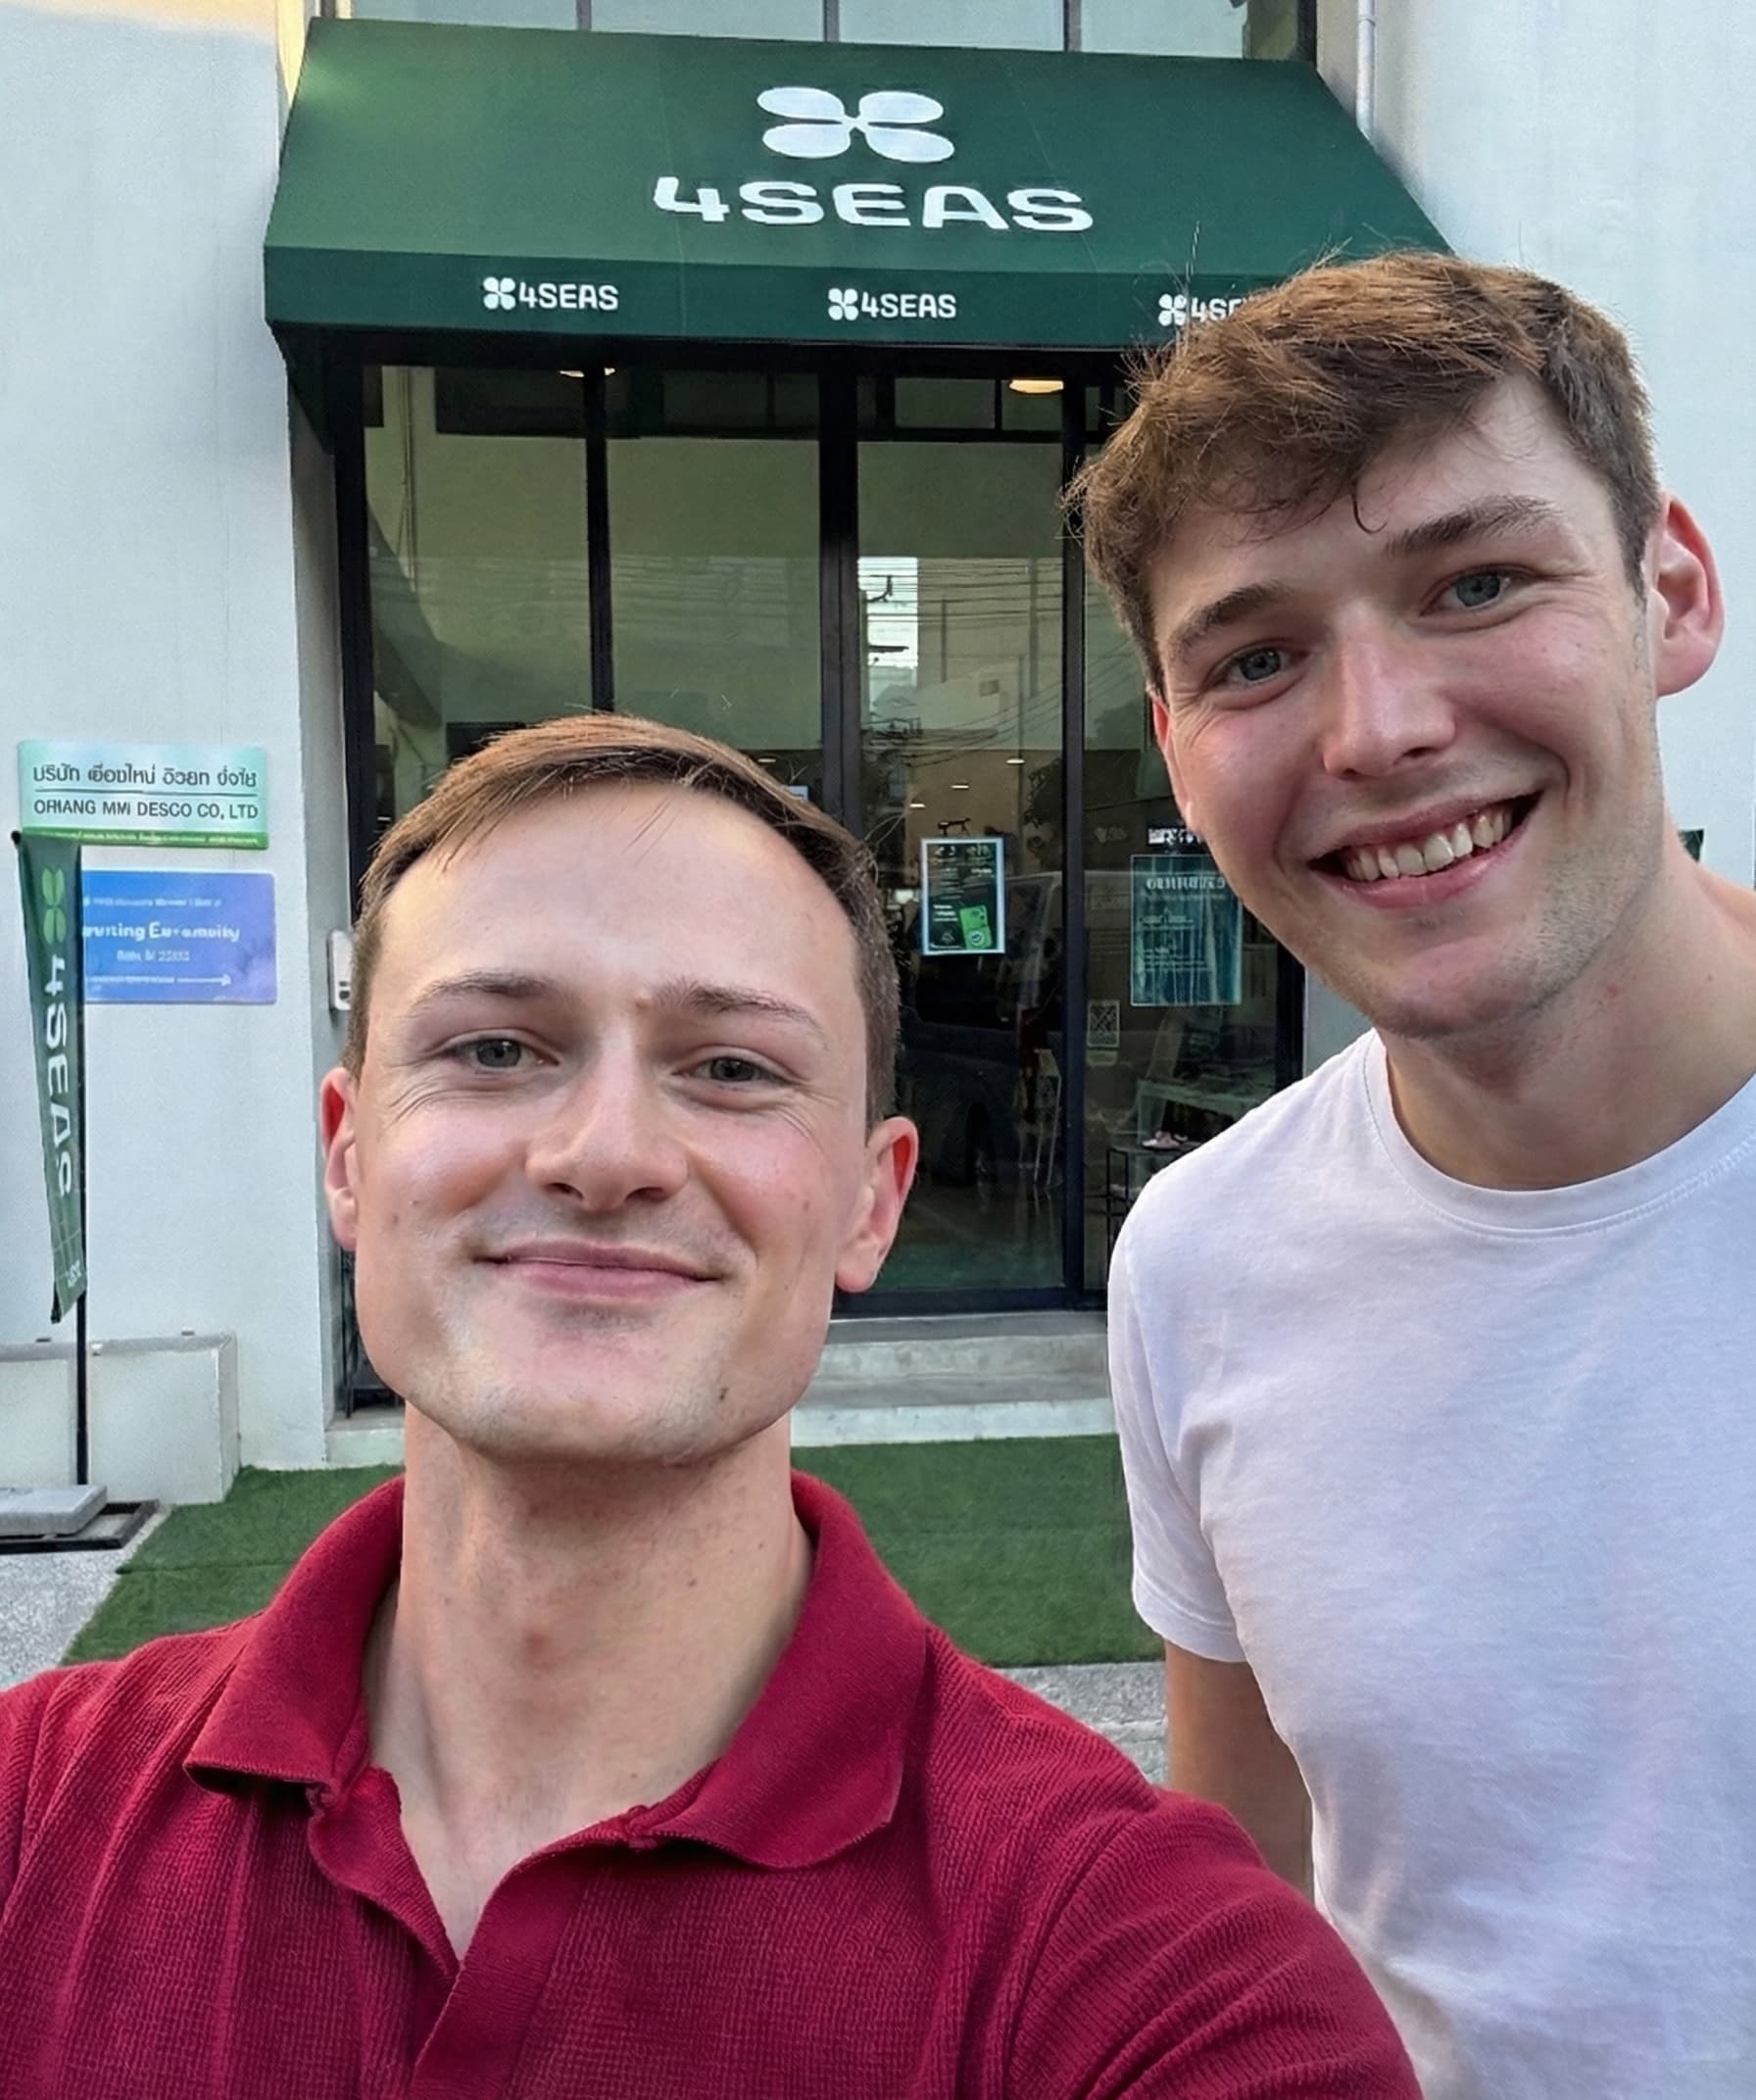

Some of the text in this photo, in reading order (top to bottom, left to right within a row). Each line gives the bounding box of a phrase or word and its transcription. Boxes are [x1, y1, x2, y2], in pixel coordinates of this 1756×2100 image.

[653, 176, 1094, 231] 4SEAS
[518, 281, 619, 311] 4SEAS
[860, 291, 956, 318] 4SEAS
[138, 802, 192, 817] DESCO
[230, 805, 259, 819] LTD
